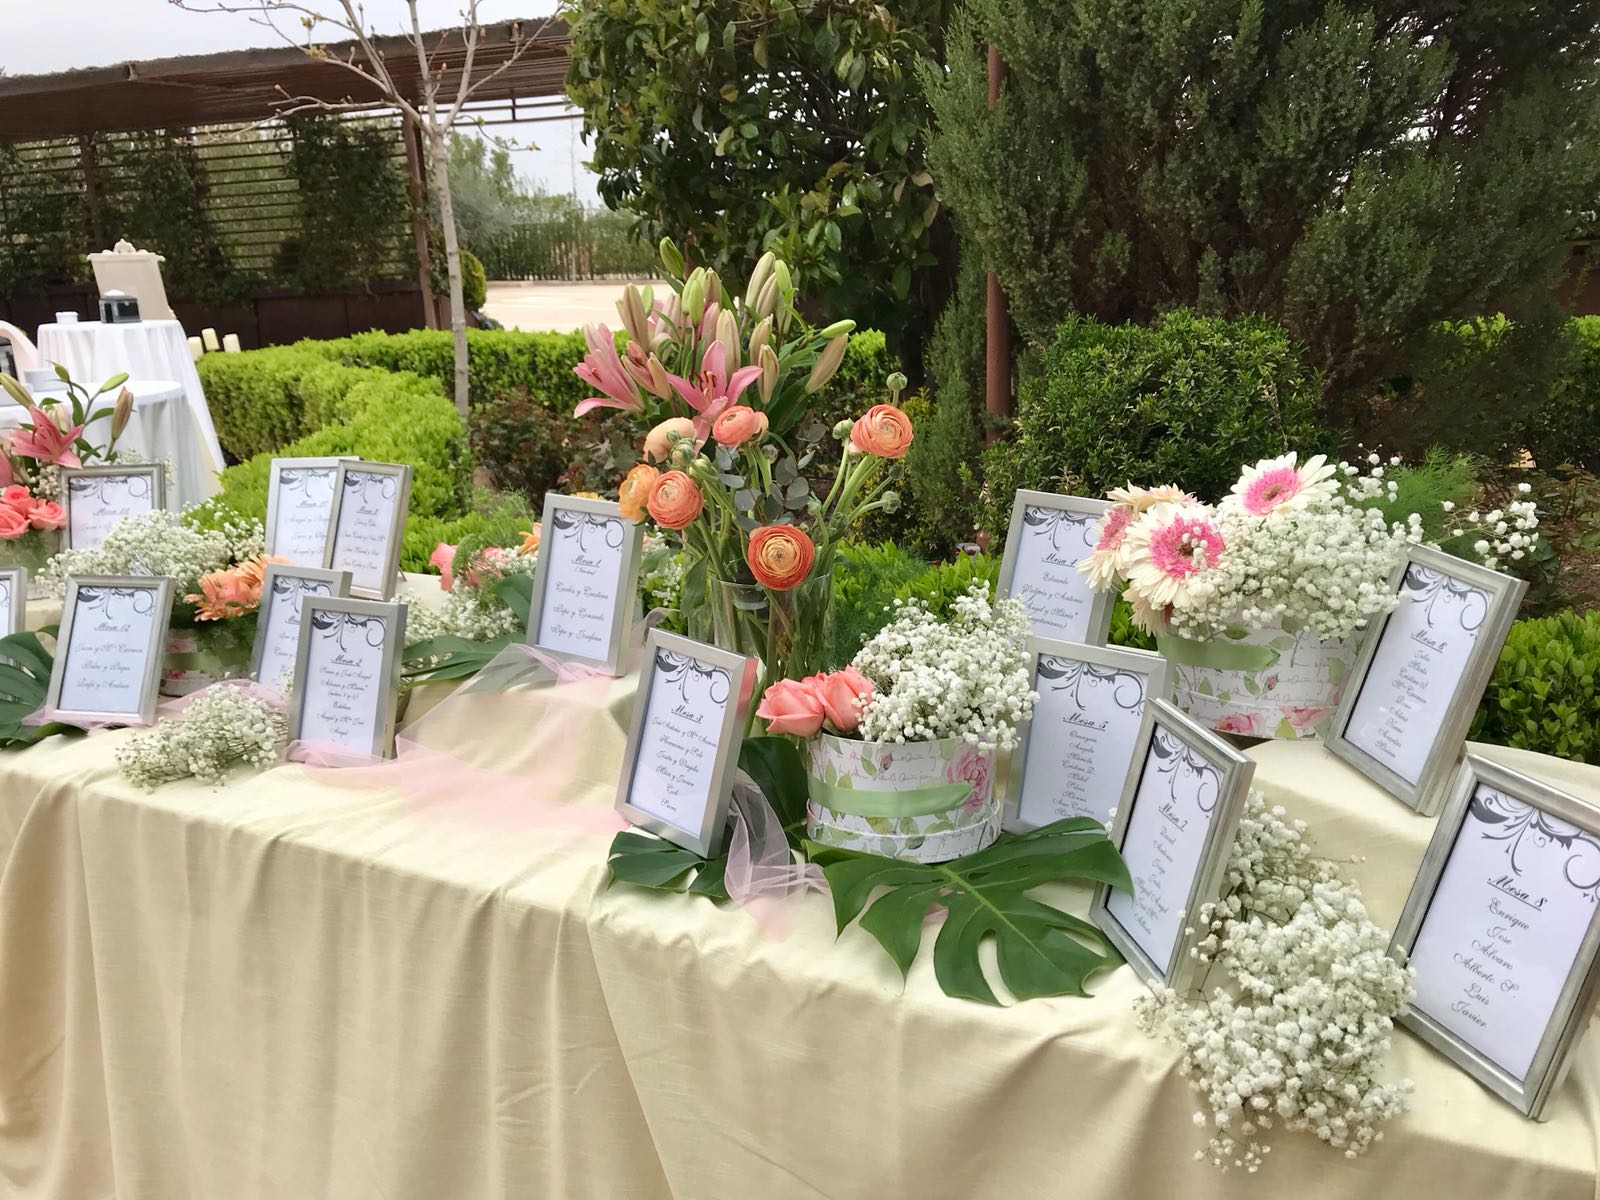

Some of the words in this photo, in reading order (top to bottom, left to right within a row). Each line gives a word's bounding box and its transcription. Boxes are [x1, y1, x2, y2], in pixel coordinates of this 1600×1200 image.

[572, 555, 593, 565] Mesa
[1041, 553, 1067, 563] Mesa
[1411, 629, 1436, 646] Mesa
[331, 655, 354, 663] Mesa
[672, 705, 694, 718] Mesa
[1063, 713, 1095, 726] Mesa
[1099, 721, 1109, 729] 5
[1488, 875, 1530, 901] Mesa
[1535, 897, 1548, 908] 8
[1488, 897, 1530, 931] Enrique
[1487, 926, 1512, 945] Jose
[1472, 940, 1513, 970] Alvaro
[1453, 952, 1495, 984] Alberto
[1464, 982, 1489, 1006] Luis
[1451, 1000, 1487, 1028] Javier
